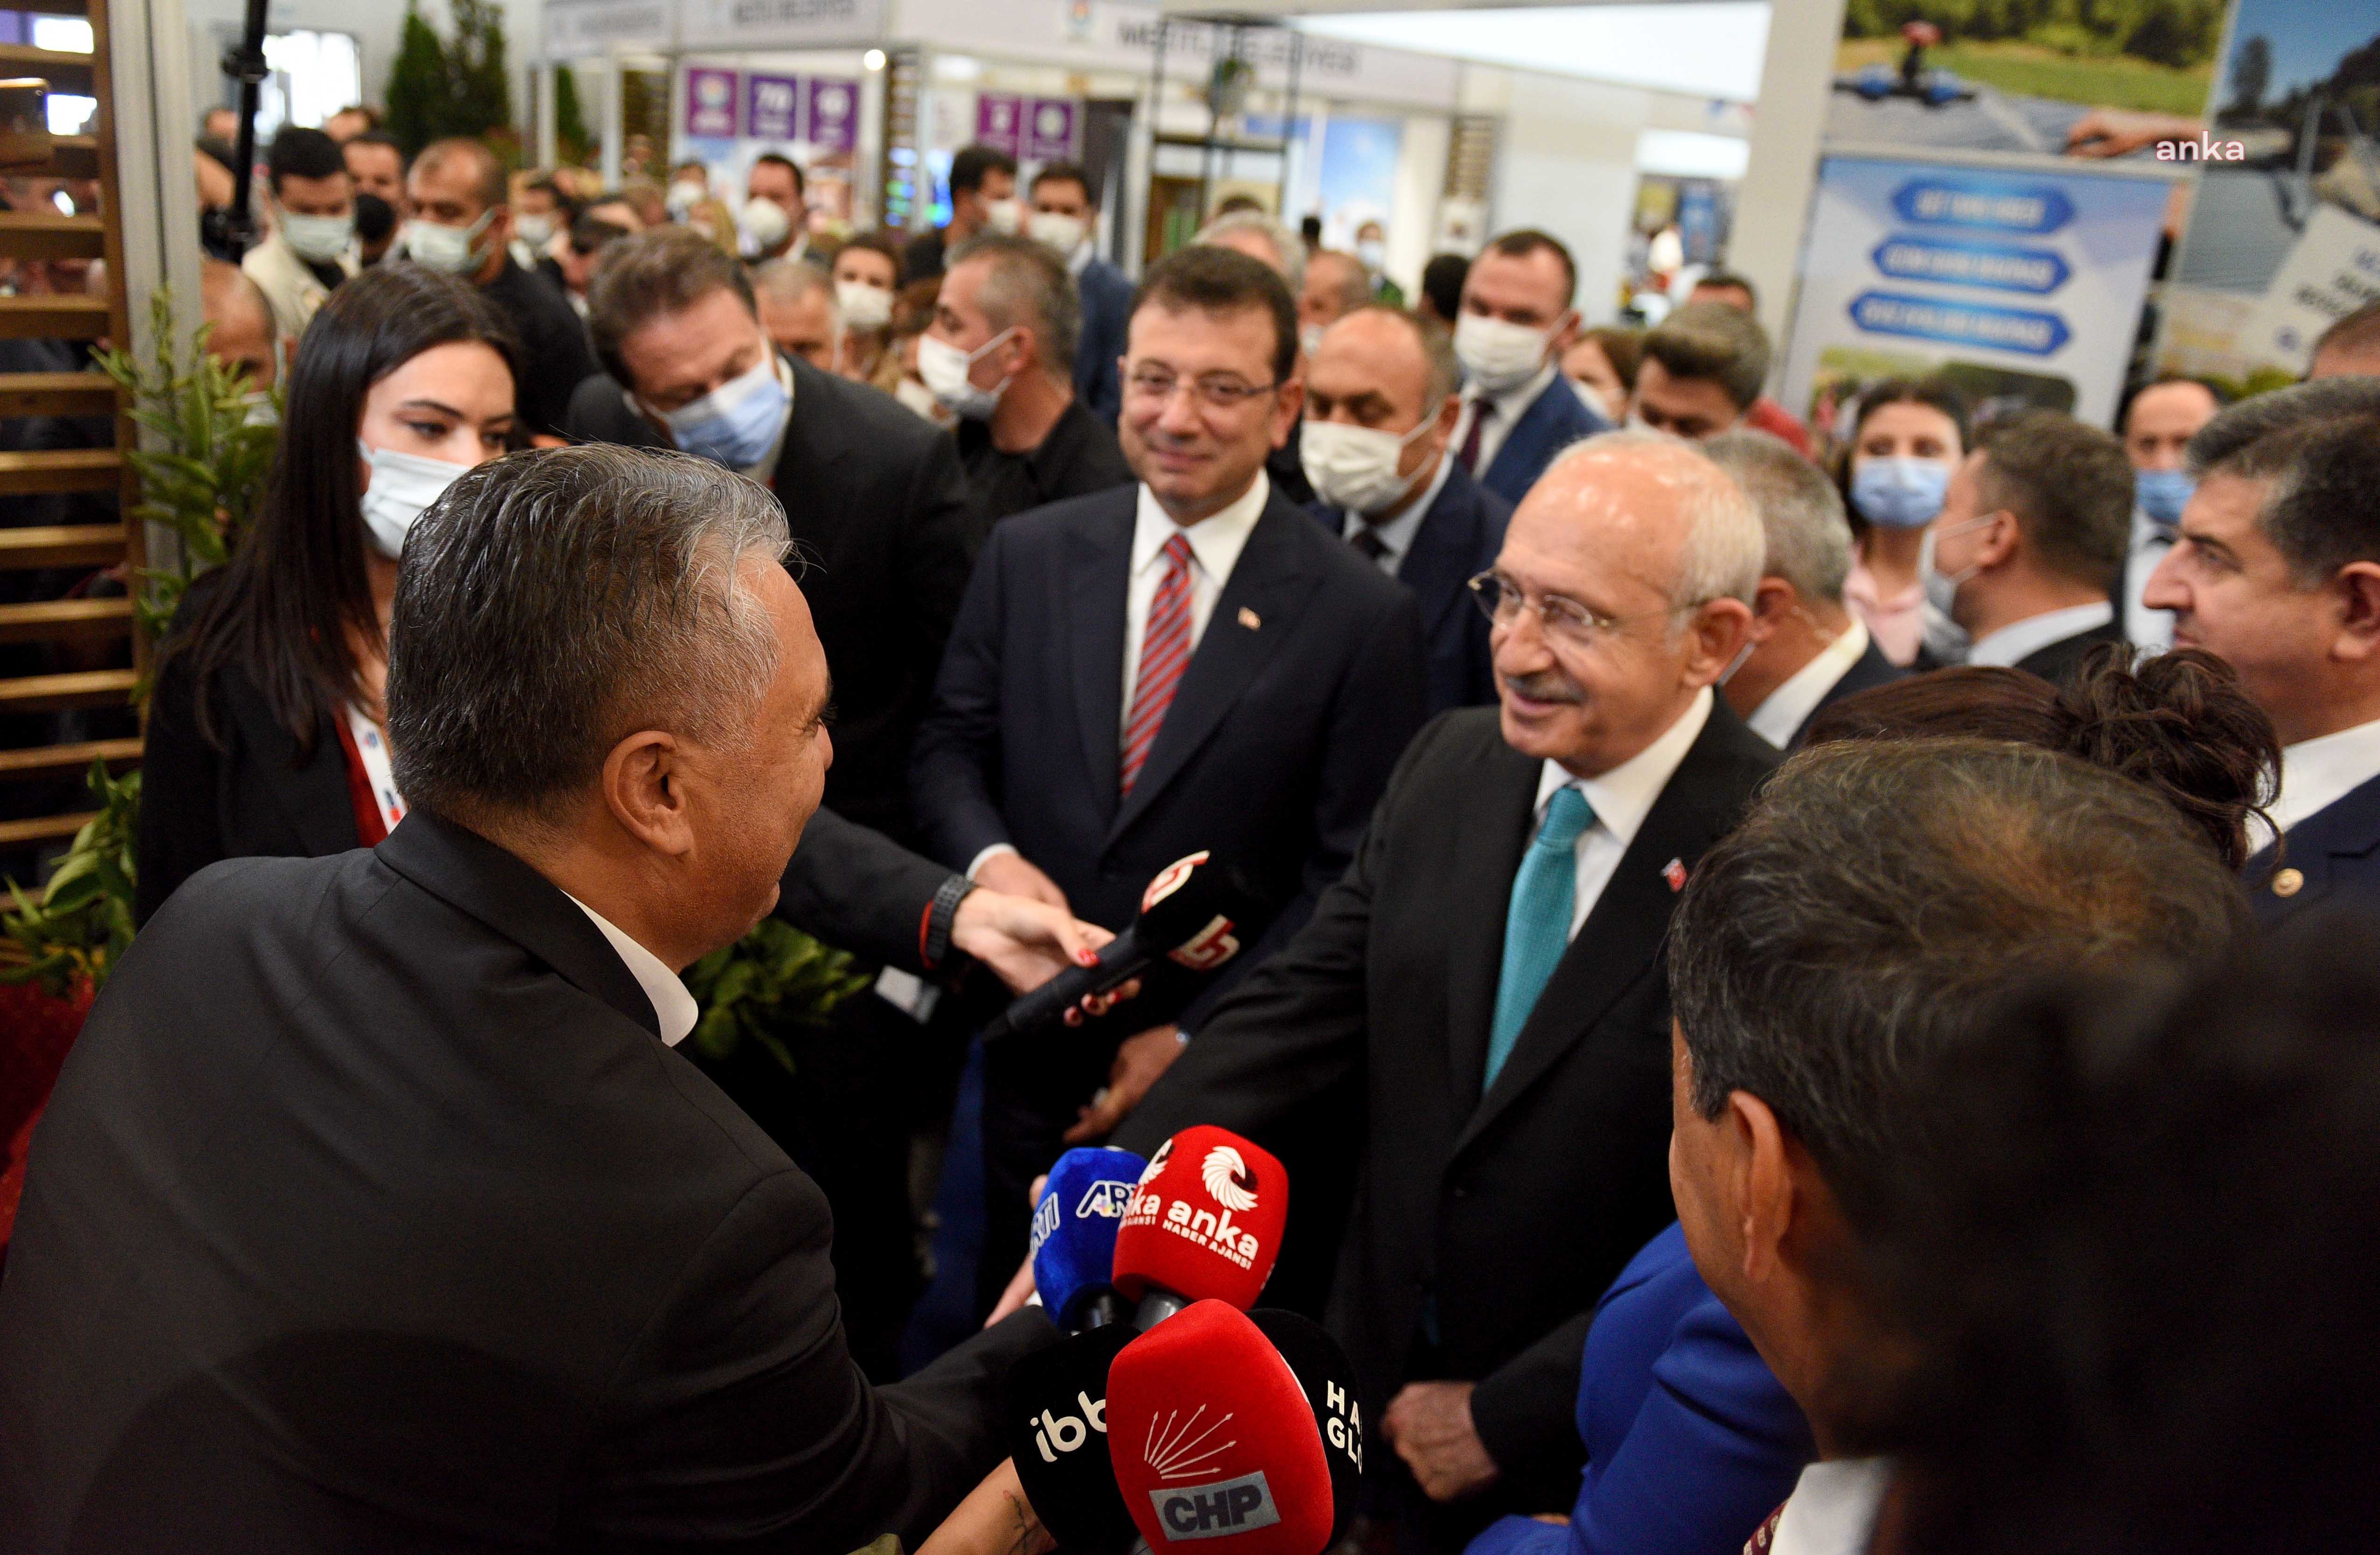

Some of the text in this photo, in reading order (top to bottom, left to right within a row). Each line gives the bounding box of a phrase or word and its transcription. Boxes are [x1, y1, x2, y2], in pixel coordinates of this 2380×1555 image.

[1162, 1219, 1208, 1246] HABER
[1167, 1200, 1259, 1261] anka
[1327, 1379, 1362, 1443] HA
[1163, 1484, 1262, 1533] CHP
